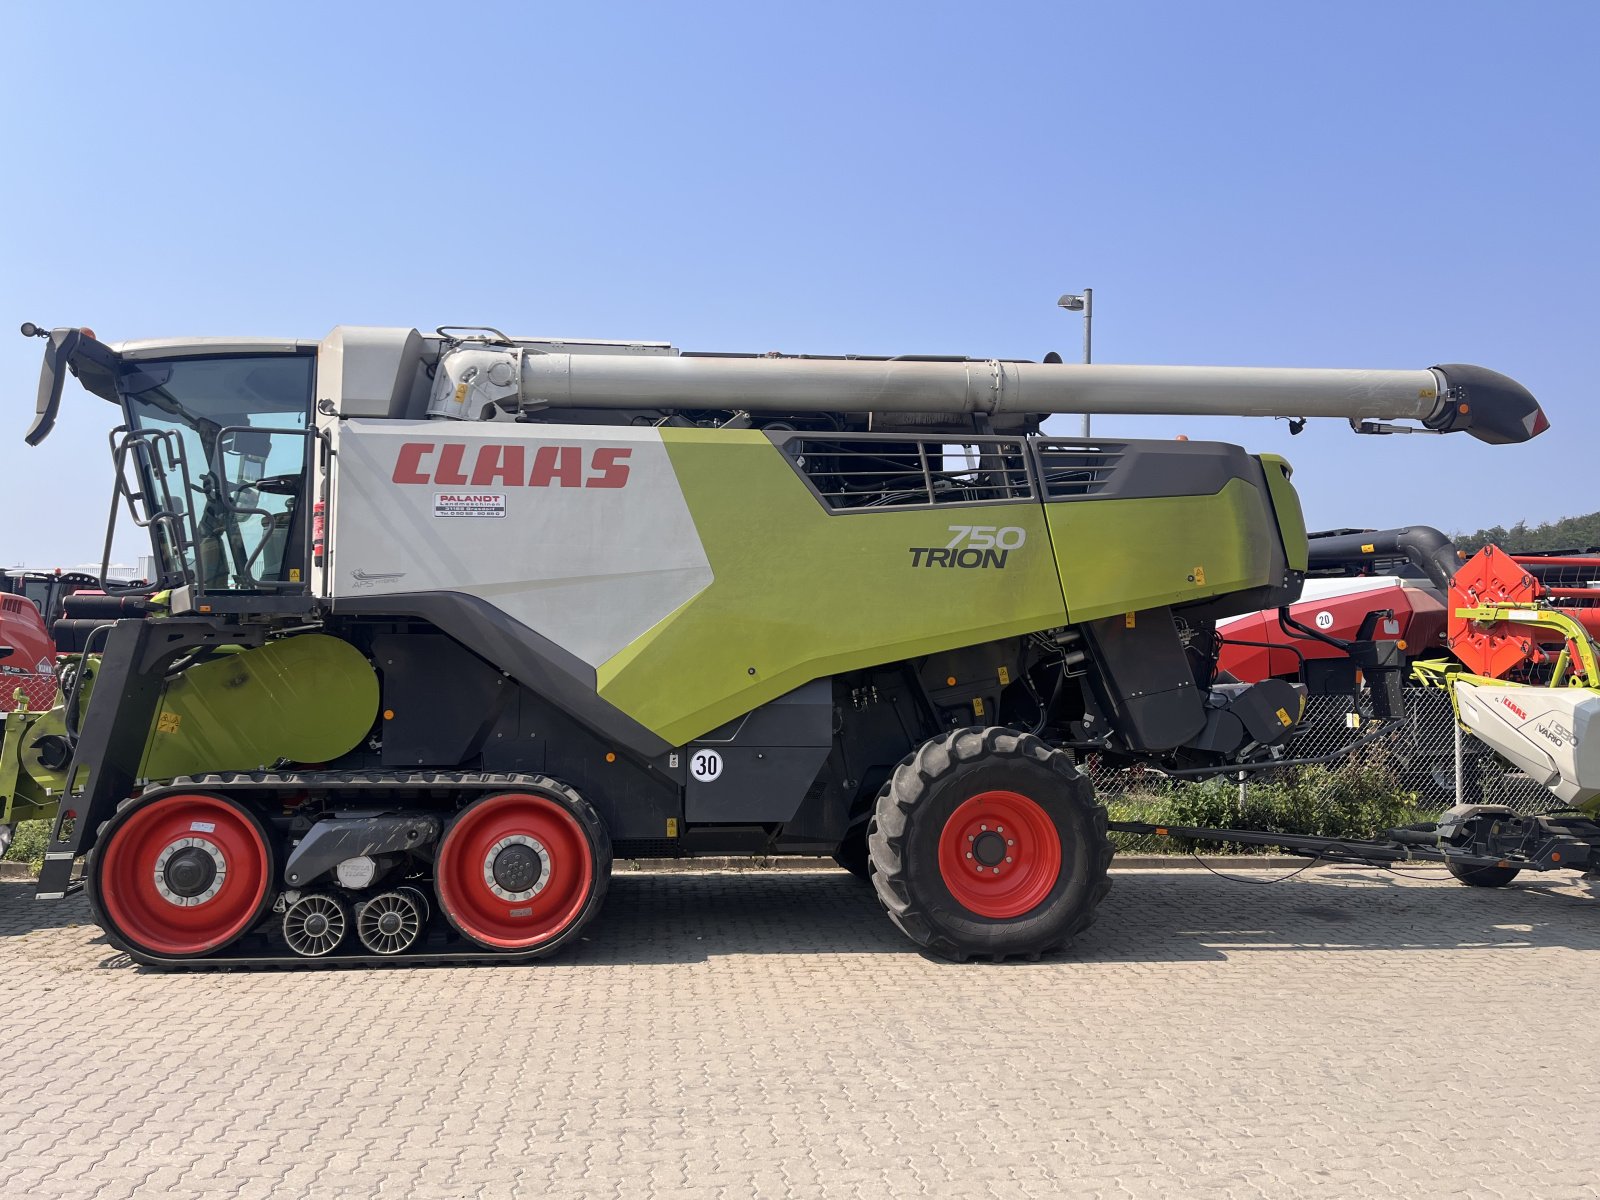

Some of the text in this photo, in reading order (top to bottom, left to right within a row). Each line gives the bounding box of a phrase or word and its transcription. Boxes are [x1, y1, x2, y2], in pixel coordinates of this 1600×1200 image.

[392, 442, 633, 489] CLAAS
[945, 525, 1026, 550] 750
[909, 547, 1009, 569] TRION
[352, 580, 375, 589] APS
[1319, 614, 1331, 626] 20
[1503, 698, 1528, 720] CLAAS
[1538, 724, 1563, 747] VARIO
[1553, 723, 1579, 747] 930
[695, 755, 717, 776] 30
